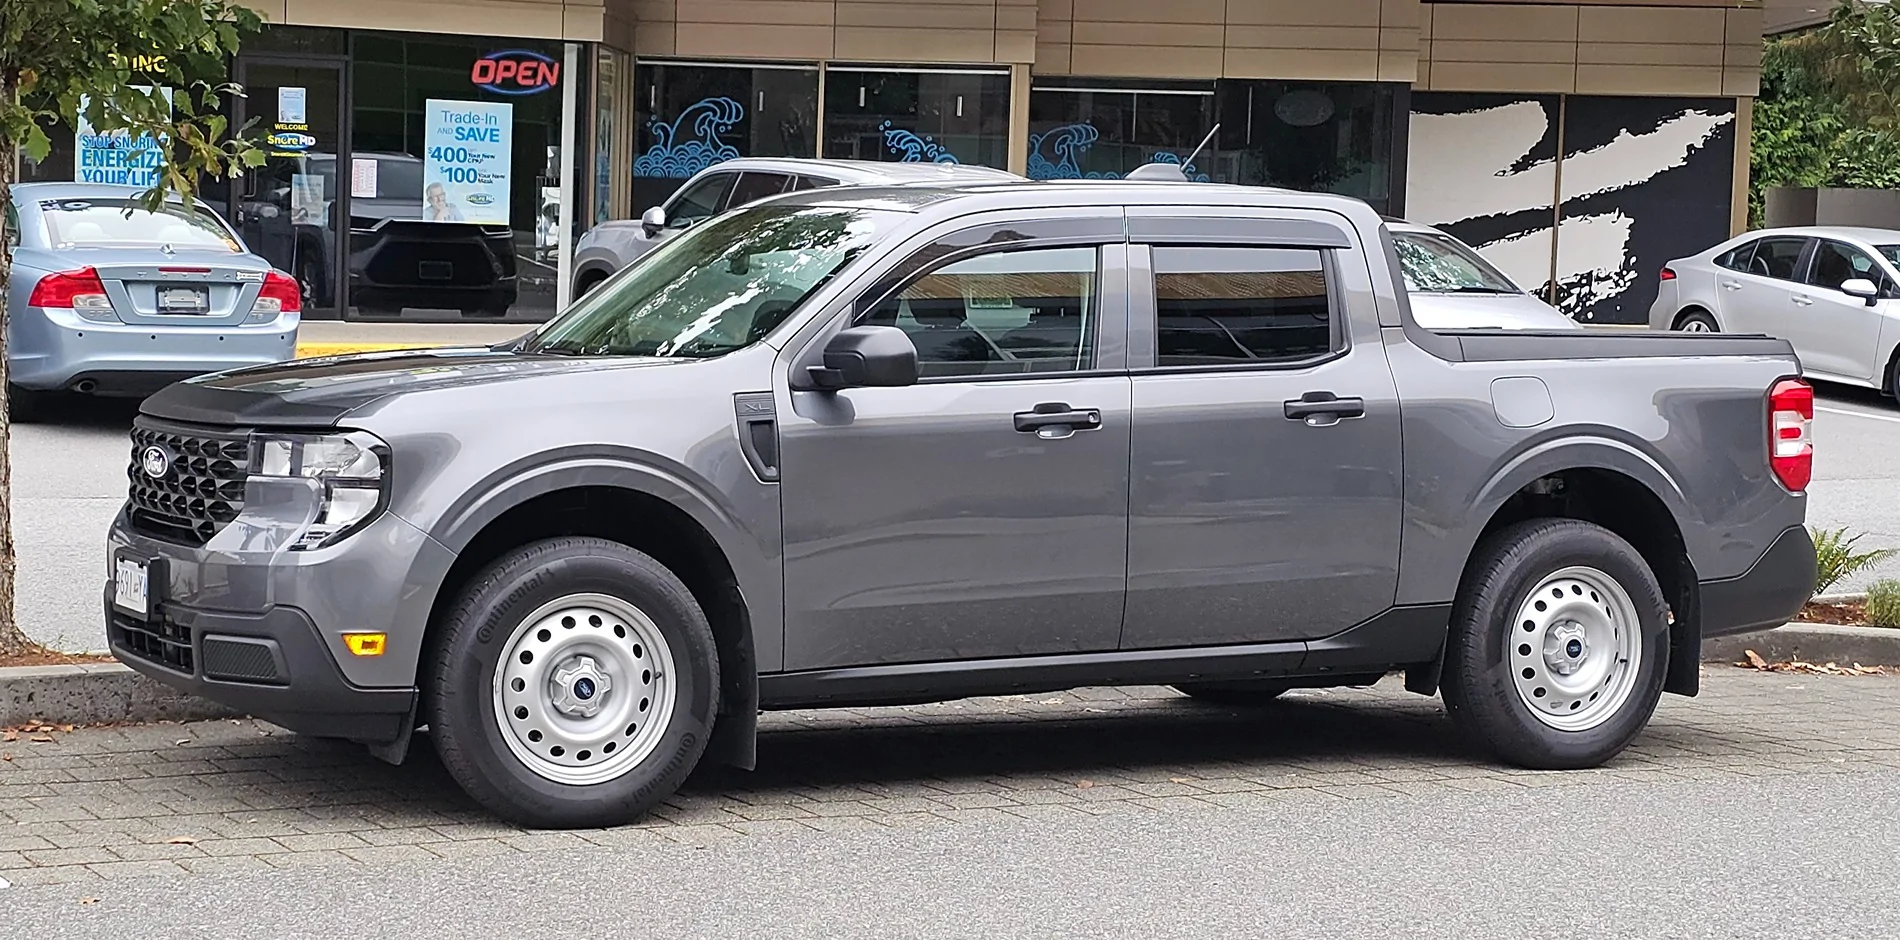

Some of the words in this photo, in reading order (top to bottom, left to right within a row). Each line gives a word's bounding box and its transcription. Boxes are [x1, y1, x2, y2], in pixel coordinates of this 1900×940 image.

[471, 59, 560, 86] OPEN
[441, 110, 498, 125] Trade-In
[274, 123, 309, 131] WELCOME
[437, 127, 454, 135] AND
[455, 126, 500, 143] SAVE
[82, 135, 111, 148] STOP
[428, 146, 468, 163] $400
[81, 169, 128, 184] YOUR
[440, 166, 478, 184] $100
[744, 402, 771, 412] XL
[146, 449, 163, 474] Ford
[476, 570, 547, 644] Continental
[632, 732, 696, 803] Continental
